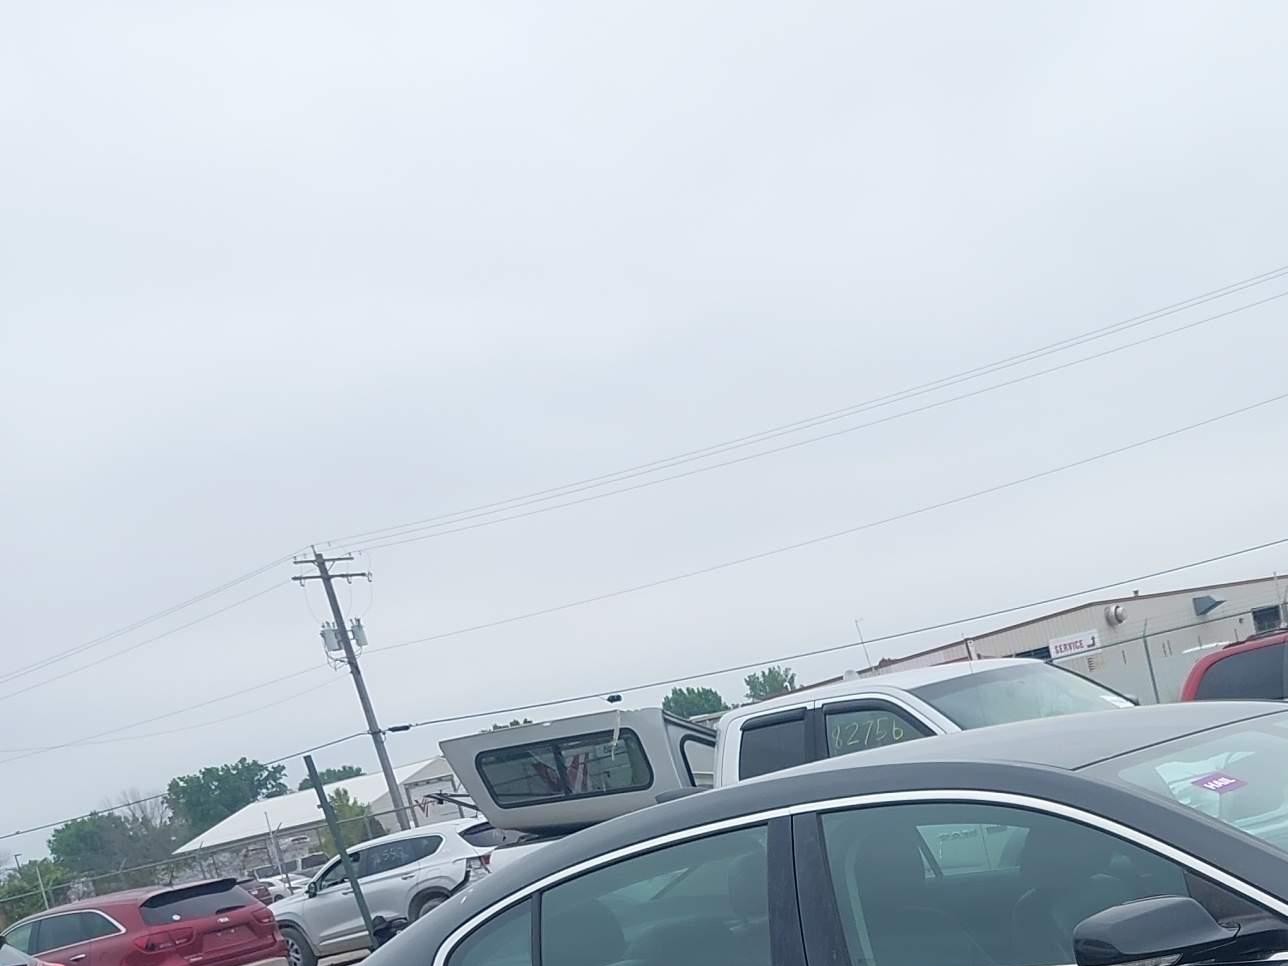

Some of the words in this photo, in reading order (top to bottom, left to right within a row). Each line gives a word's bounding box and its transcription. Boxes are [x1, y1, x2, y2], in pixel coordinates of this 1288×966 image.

[1054, 639, 1085, 655] SERVICE
[831, 716, 904, 750] 82756
[1203, 776, 1236, 790] HAIL
